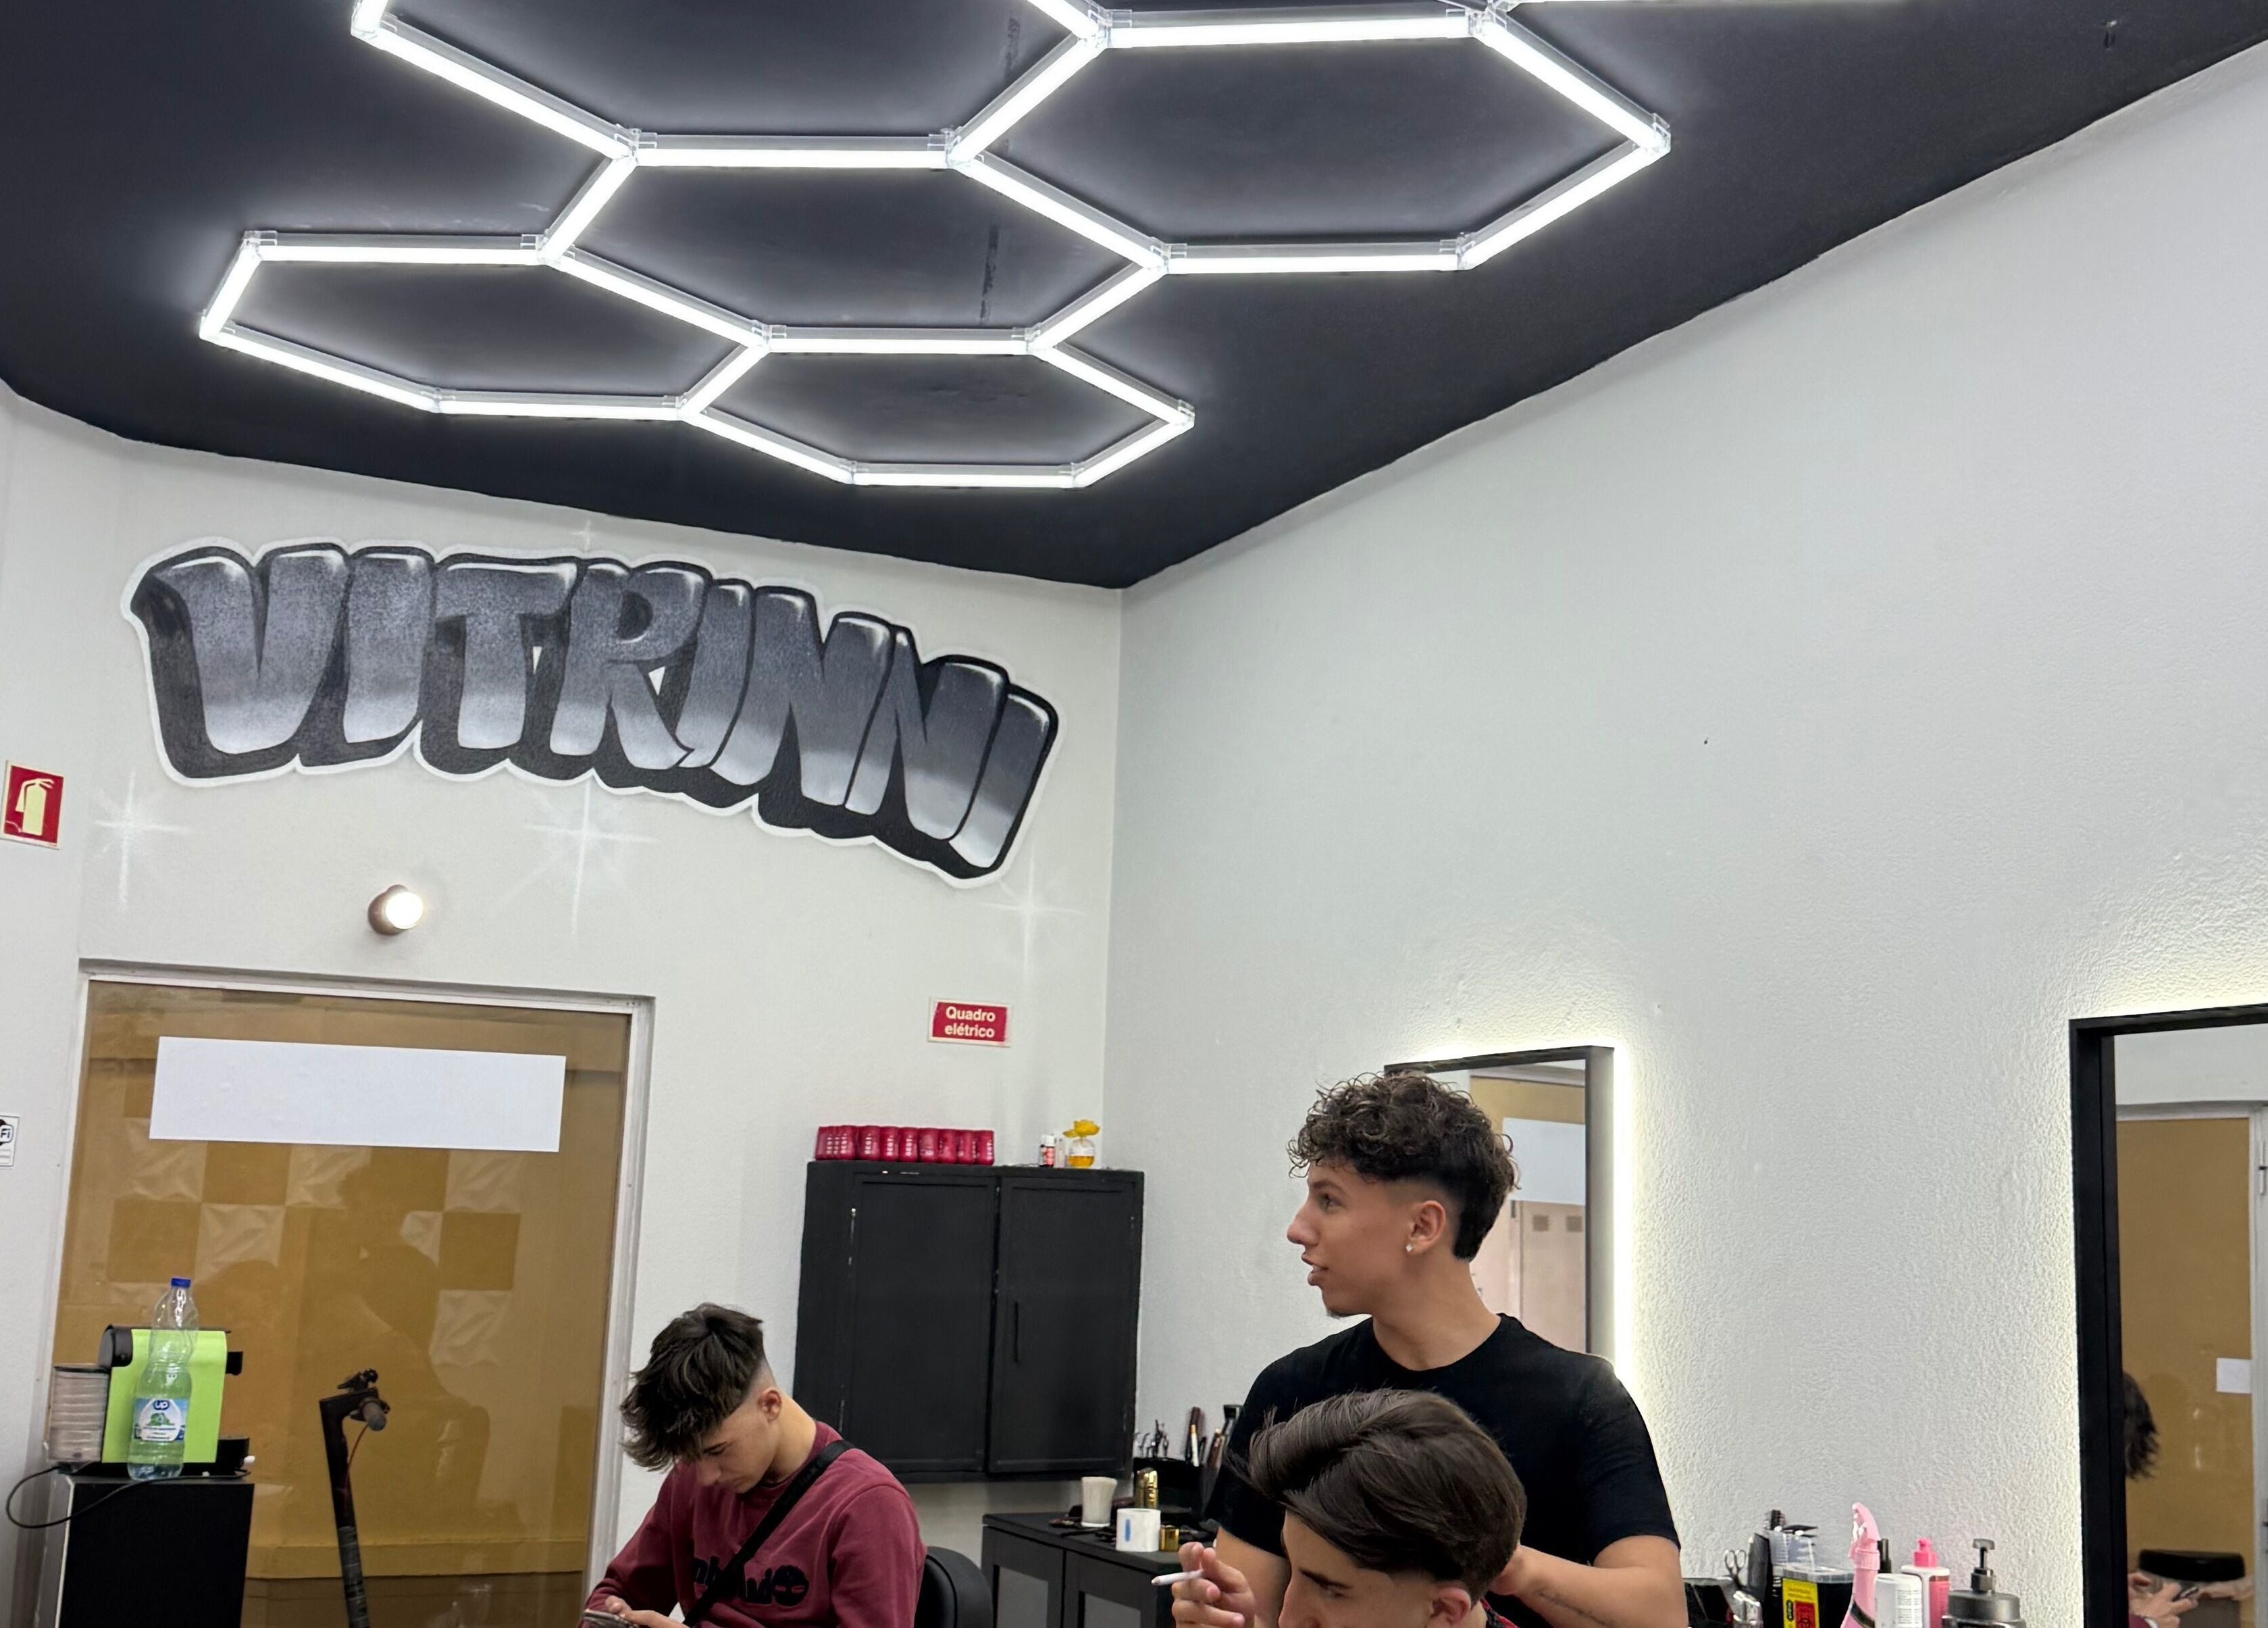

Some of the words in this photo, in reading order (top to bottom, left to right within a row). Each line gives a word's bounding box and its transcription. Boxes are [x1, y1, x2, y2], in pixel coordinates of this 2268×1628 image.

[128, 540, 1059, 880] VITRINNI
[946, 1006, 996, 1022] Quadro
[944, 1022, 995, 1038] elétrico
